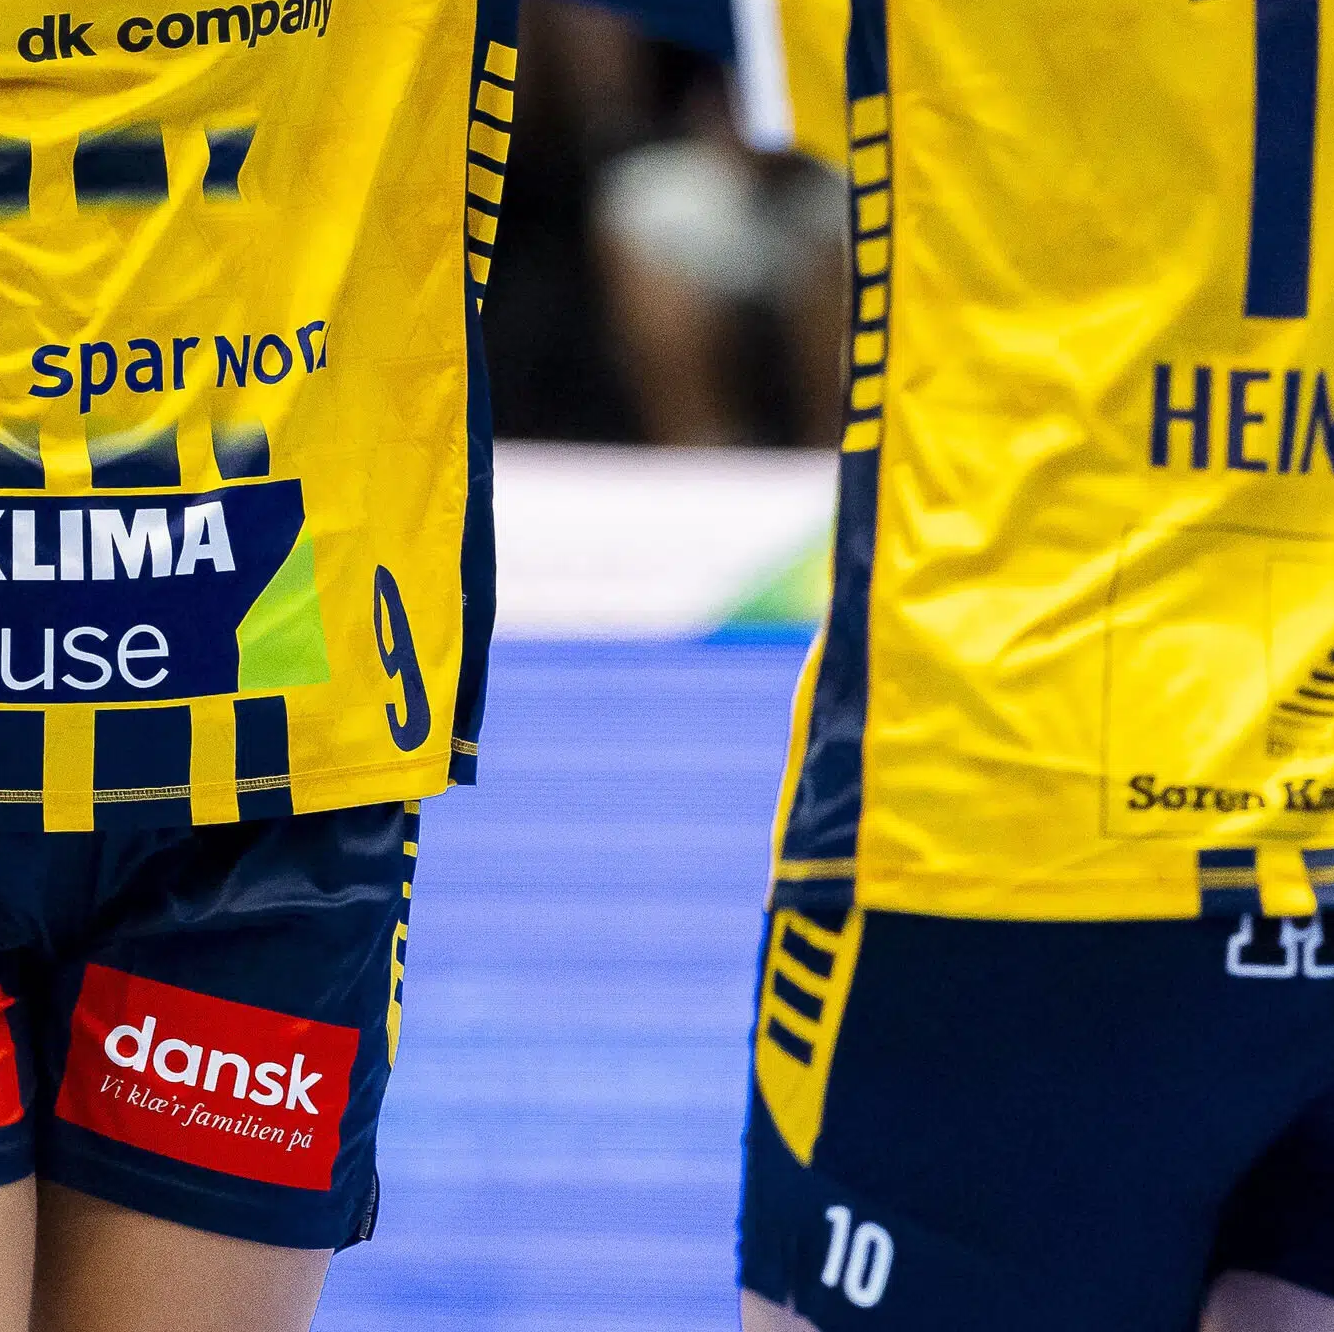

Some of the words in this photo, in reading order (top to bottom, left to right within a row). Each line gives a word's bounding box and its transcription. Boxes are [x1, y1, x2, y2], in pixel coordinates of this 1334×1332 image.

[17, 13, 98, 63] dk
[373, 564, 431, 752] 9
[100, 1074, 124, 1099] Vi
[181, 1103, 285, 1144] familien
[286, 1127, 314, 1153] på
[104, 1015, 324, 1116] dansk
[820, 1204, 895, 1308] 10
